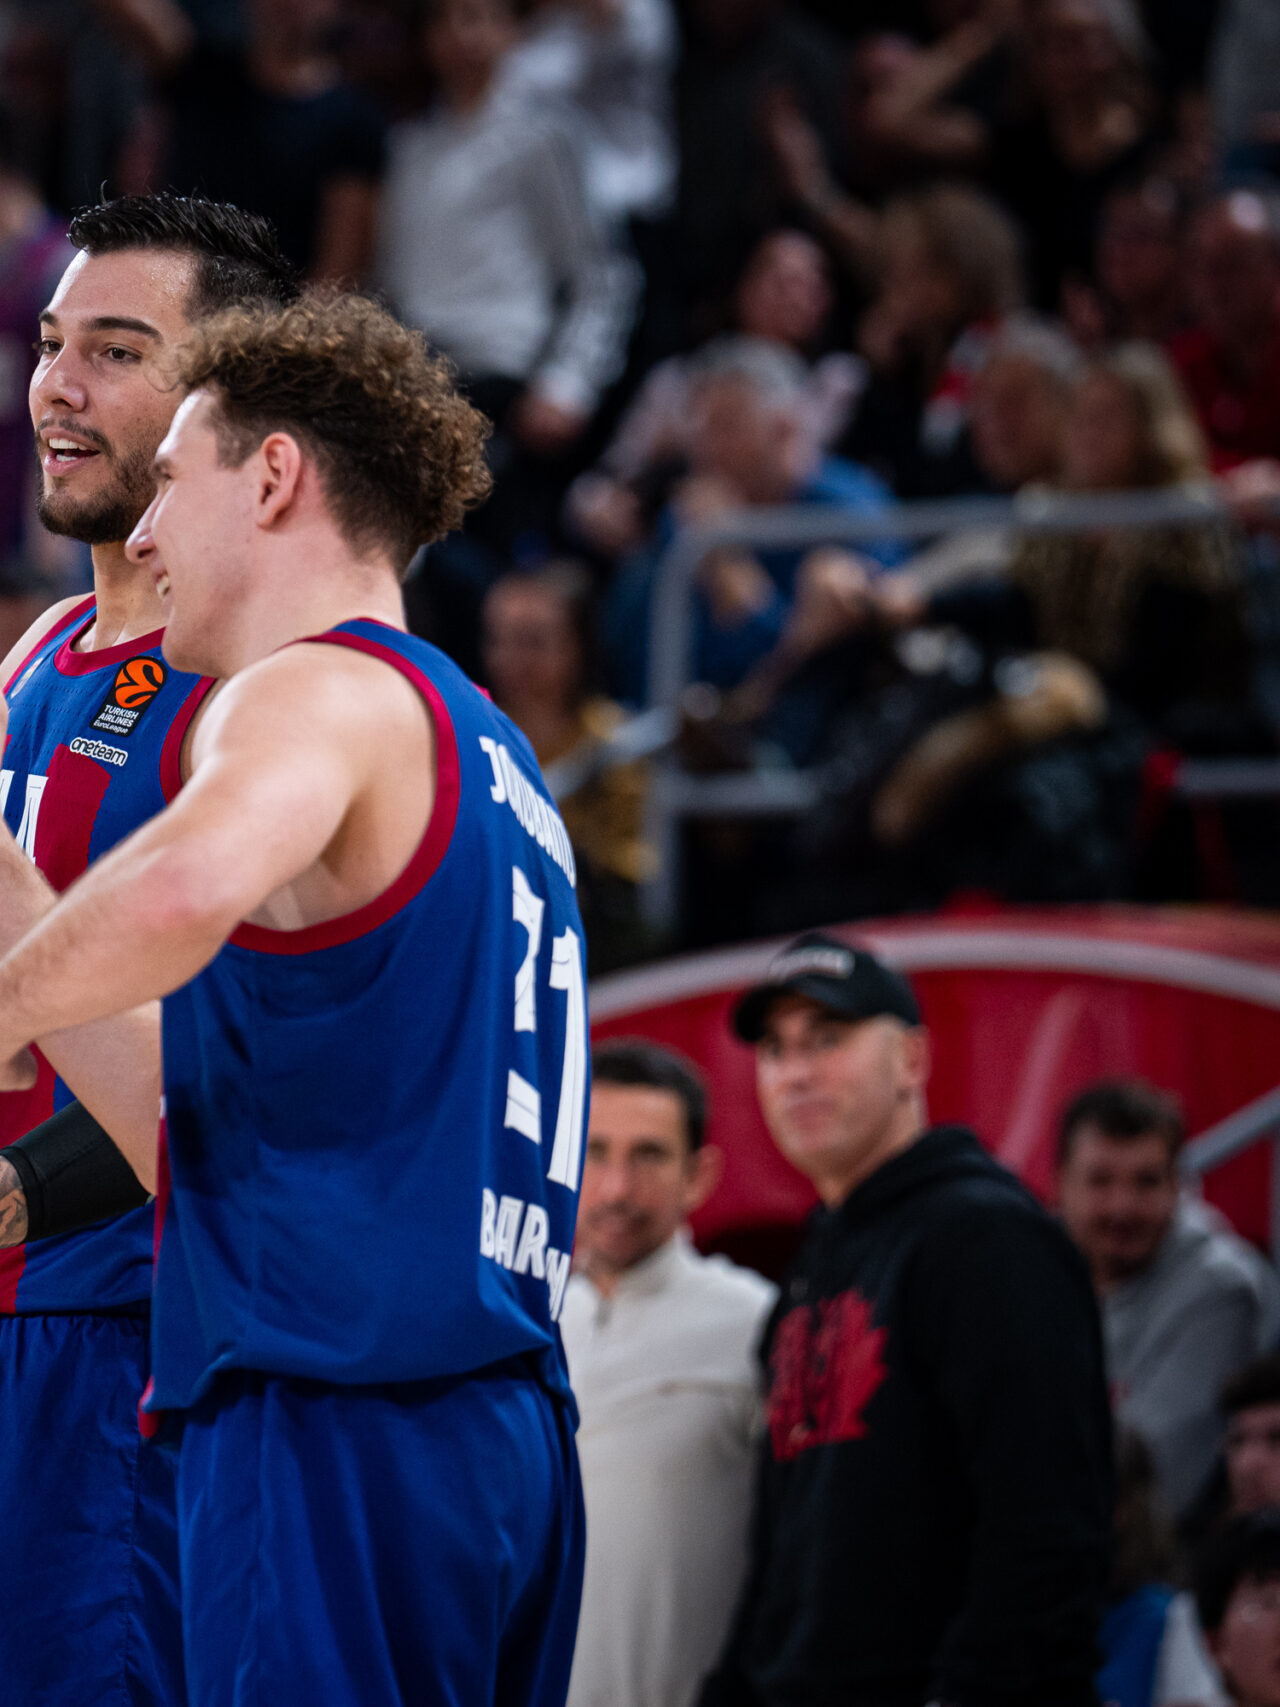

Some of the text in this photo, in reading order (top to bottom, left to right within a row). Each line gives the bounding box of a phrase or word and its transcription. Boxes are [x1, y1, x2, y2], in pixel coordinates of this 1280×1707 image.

[104, 704, 139, 719] TURKISH
[93, 719, 129, 733] EuroLeague
[98, 712, 134, 727] AIRLINES
[70, 737, 128, 766] oneteam
